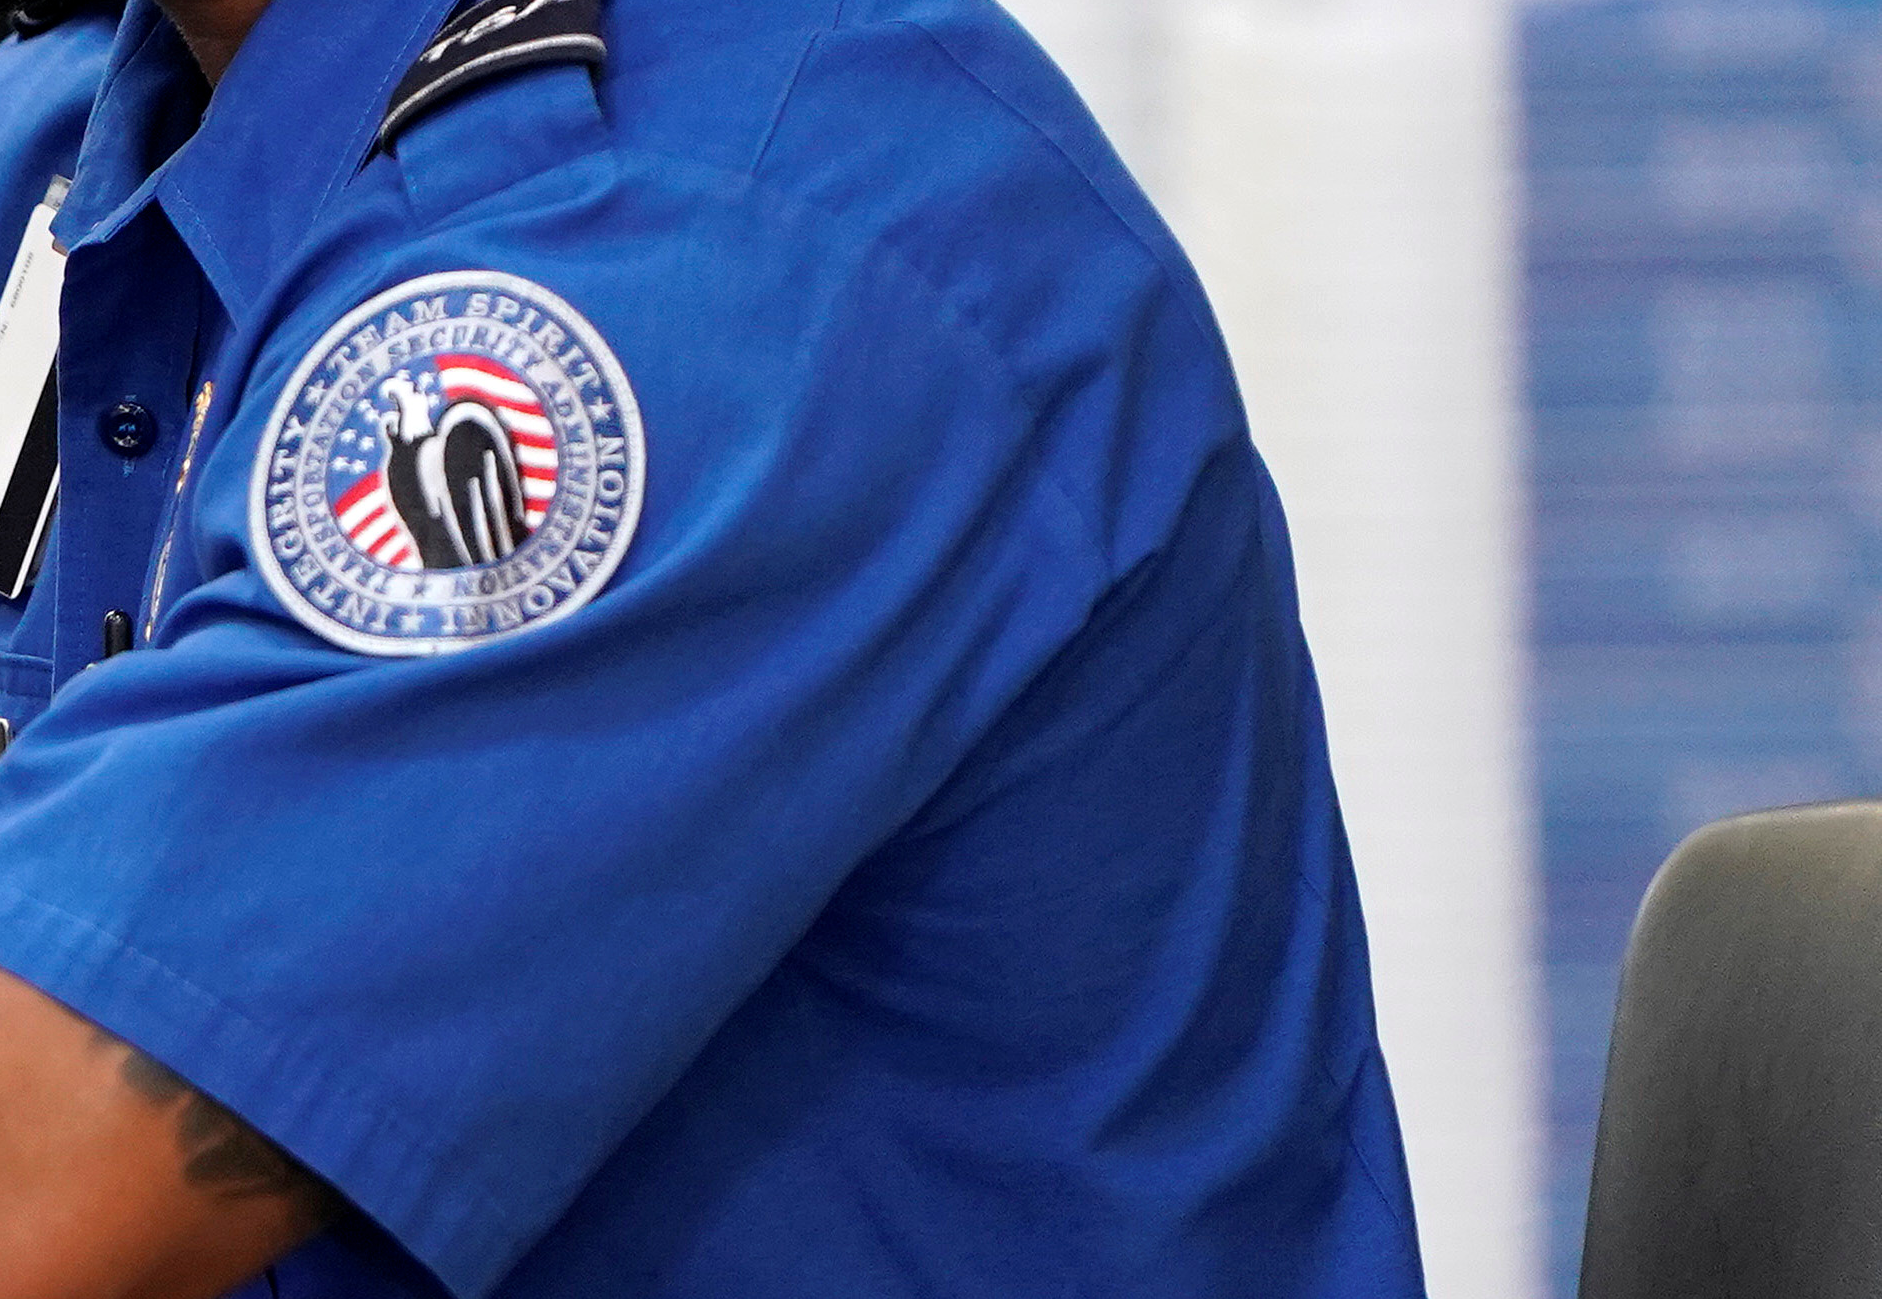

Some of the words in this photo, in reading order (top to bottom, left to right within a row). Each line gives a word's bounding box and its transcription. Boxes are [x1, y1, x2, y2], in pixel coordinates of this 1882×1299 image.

[328, 294, 448, 372] TEAM
[467, 291, 603, 400] SPIRIT
[388, 322, 541, 373] SECURITY
[267, 413, 389, 634] INTEGRITY
[301, 364, 401, 594] TRANSPORTATION
[440, 435, 627, 632] INNOVATION
[463, 379, 595, 597] ADMINISTRATION
